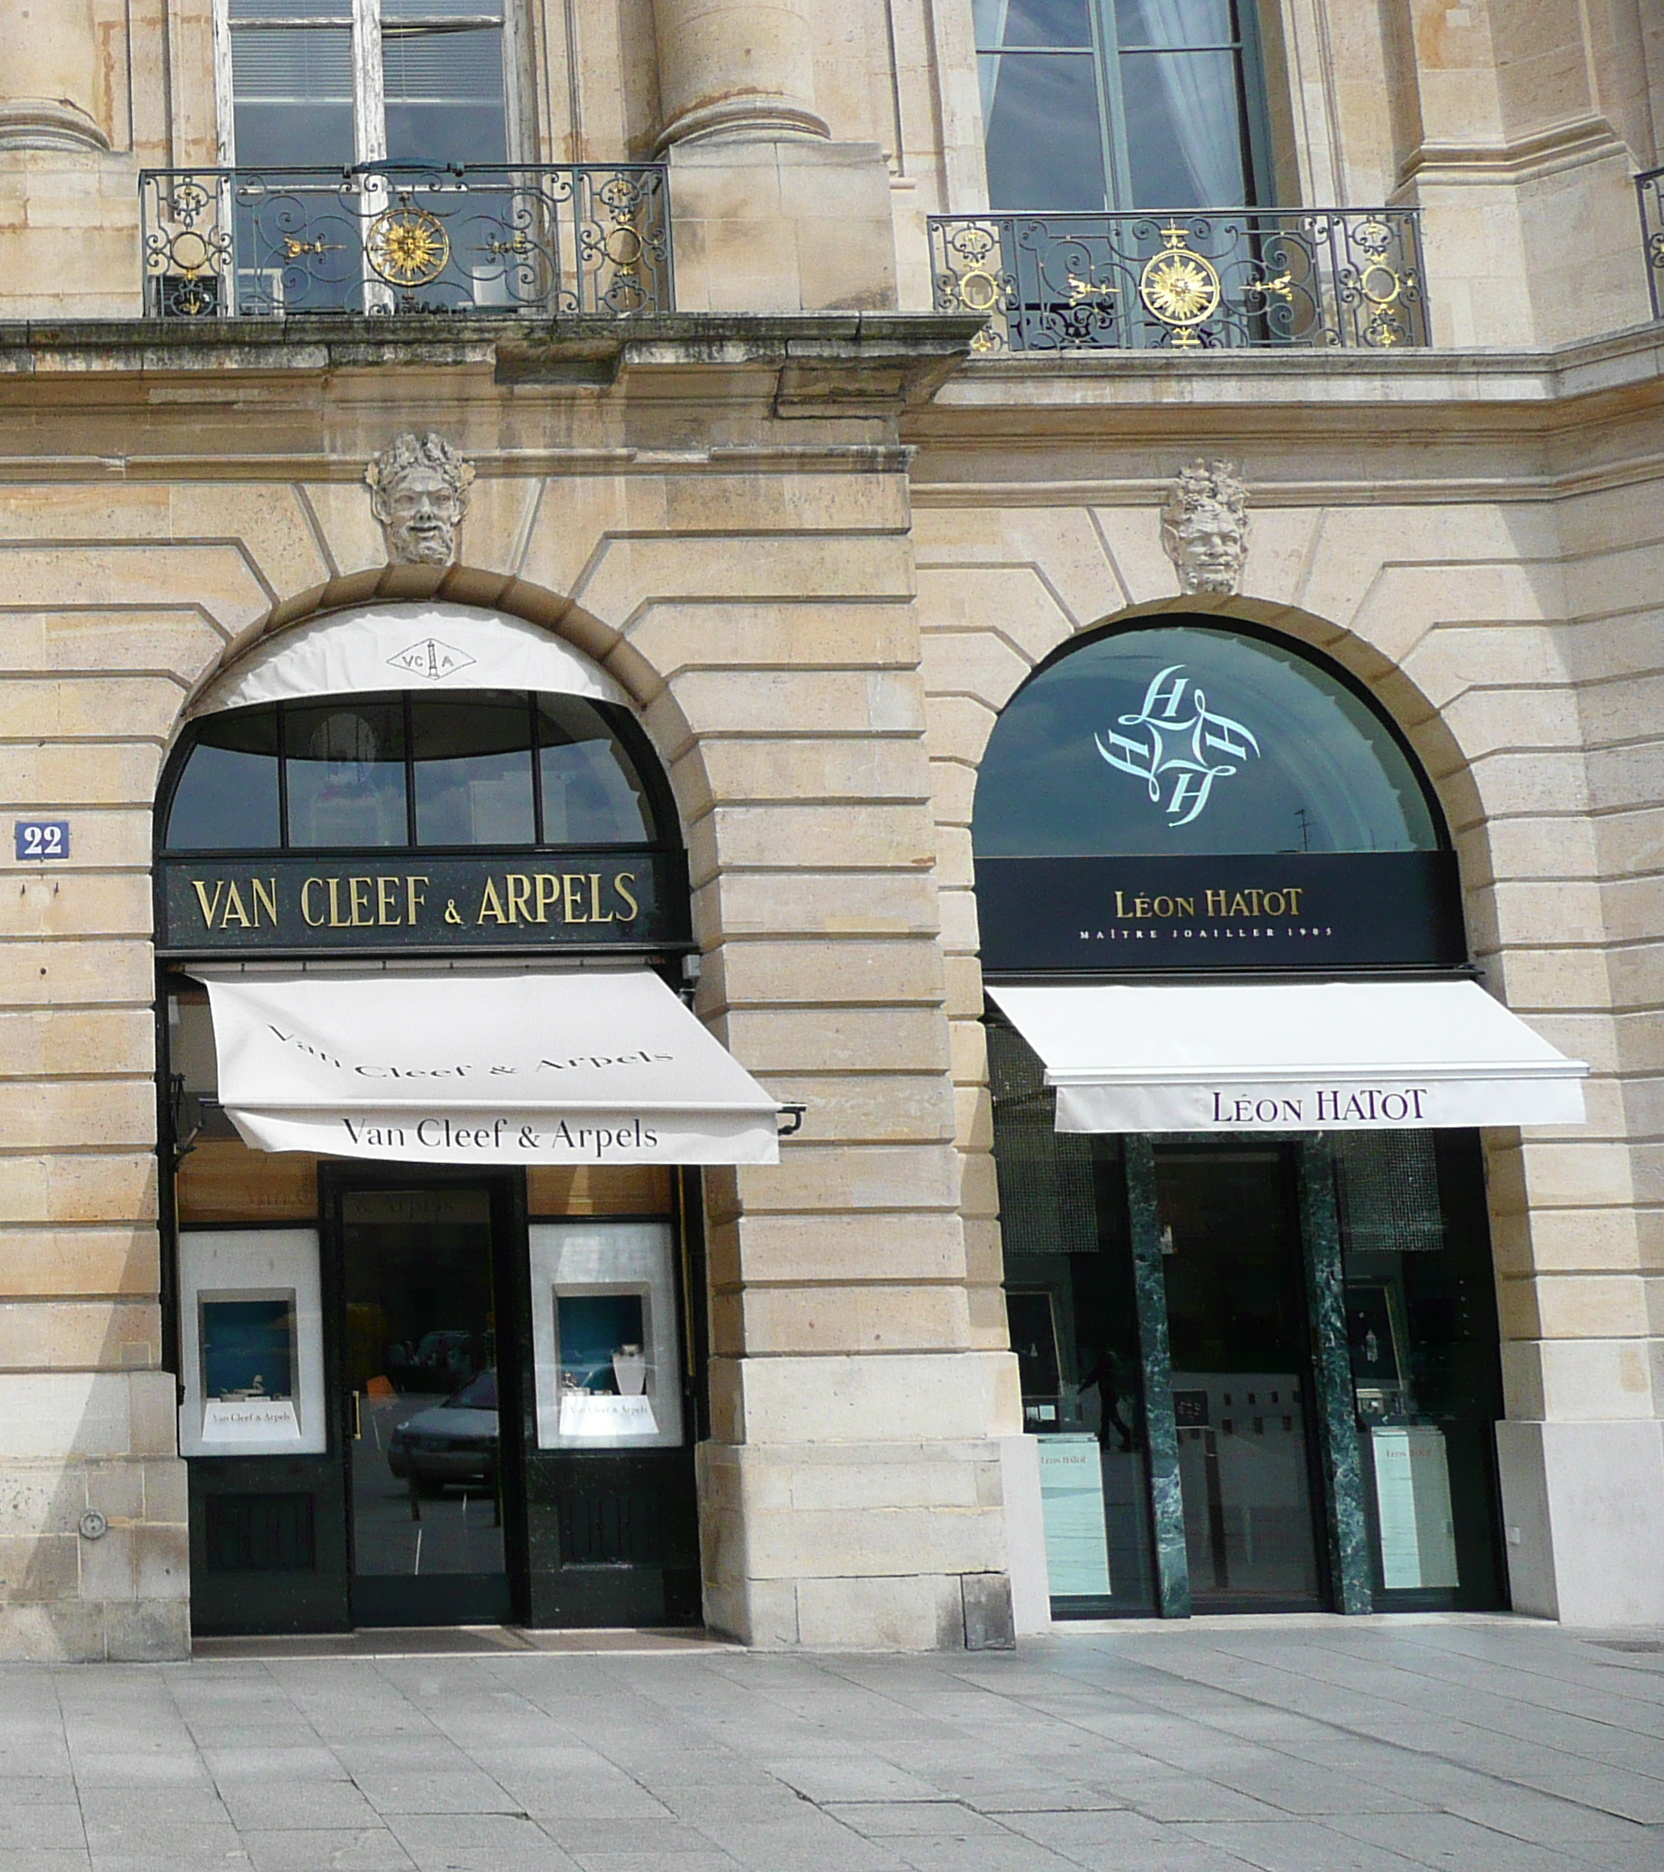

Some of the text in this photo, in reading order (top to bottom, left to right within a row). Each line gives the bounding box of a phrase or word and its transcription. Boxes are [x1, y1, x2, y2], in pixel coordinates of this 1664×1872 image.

[401, 655, 454, 667] VC A
[24, 826, 62, 855] 22
[192, 872, 638, 929] VAN CLEEF & ARPELS
[1114, 887, 1303, 918] LÉON HATOT
[1173, 928, 1275, 939] JOAILLER
[267, 1022, 674, 1079] Van Cleef & Arpels
[1212, 1088, 1427, 1123] LÉON HATOT
[342, 1118, 659, 1158] Van Cleef & Arpels
